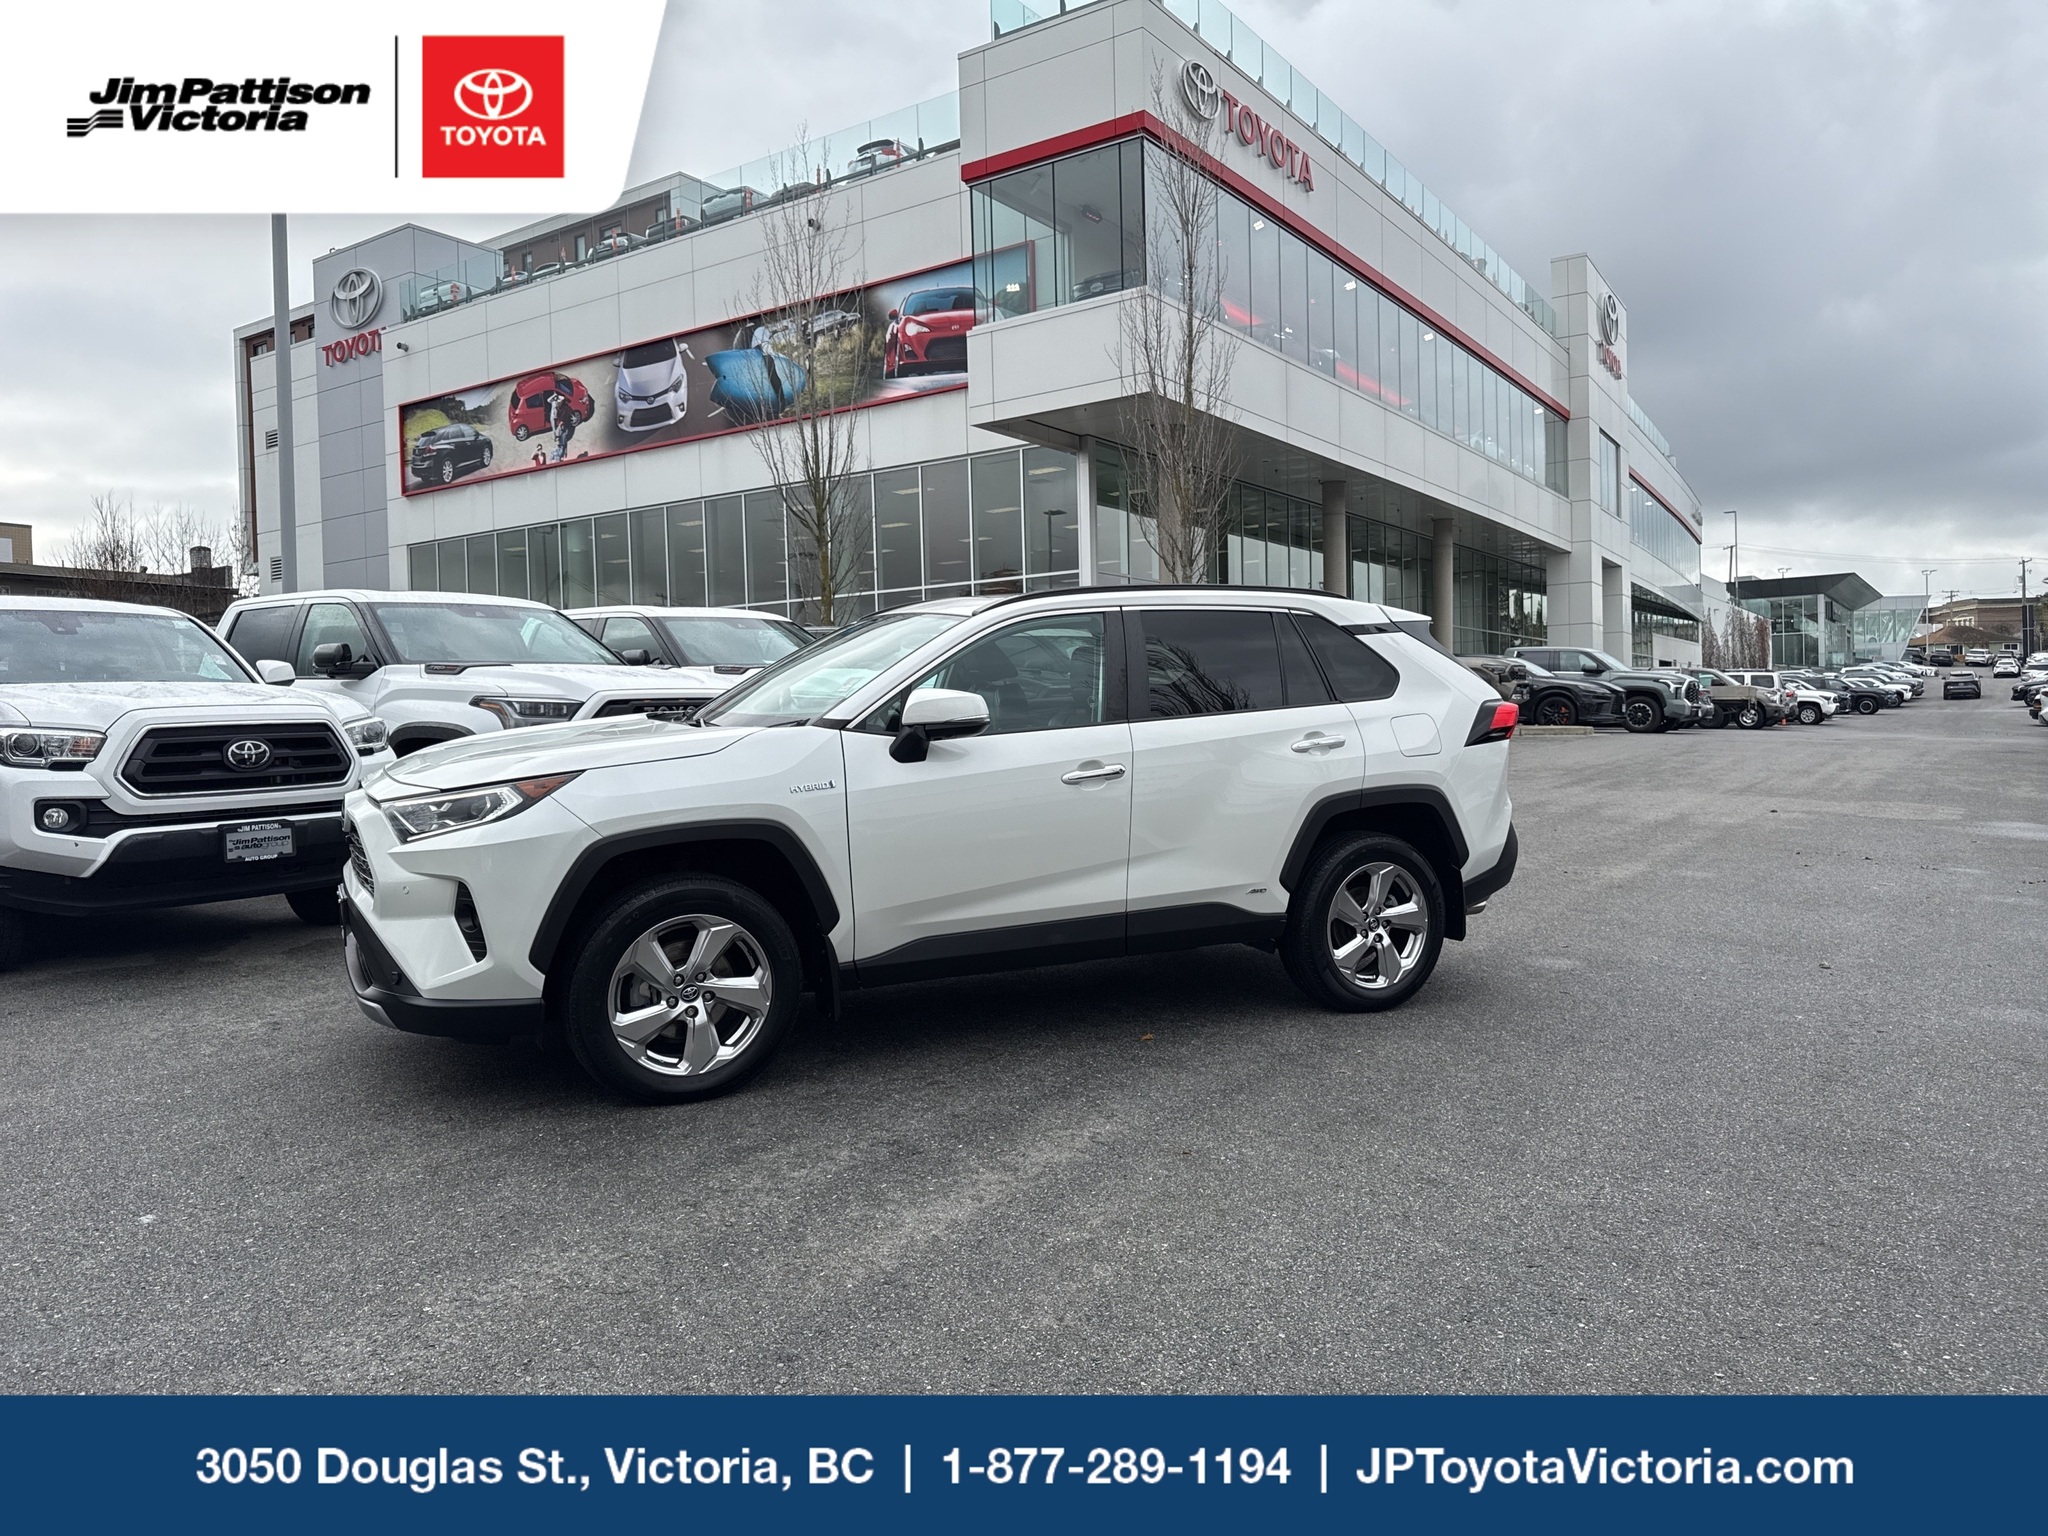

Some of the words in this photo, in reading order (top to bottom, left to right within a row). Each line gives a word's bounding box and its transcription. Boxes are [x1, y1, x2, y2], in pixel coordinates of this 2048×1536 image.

[1222, 89, 1314, 192] TOYOTA
[321, 326, 386, 367] TOYOT
[789, 782, 830, 794] HYBRID
[239, 824, 250, 832] JIM
[251, 823, 279, 832] PATTISON
